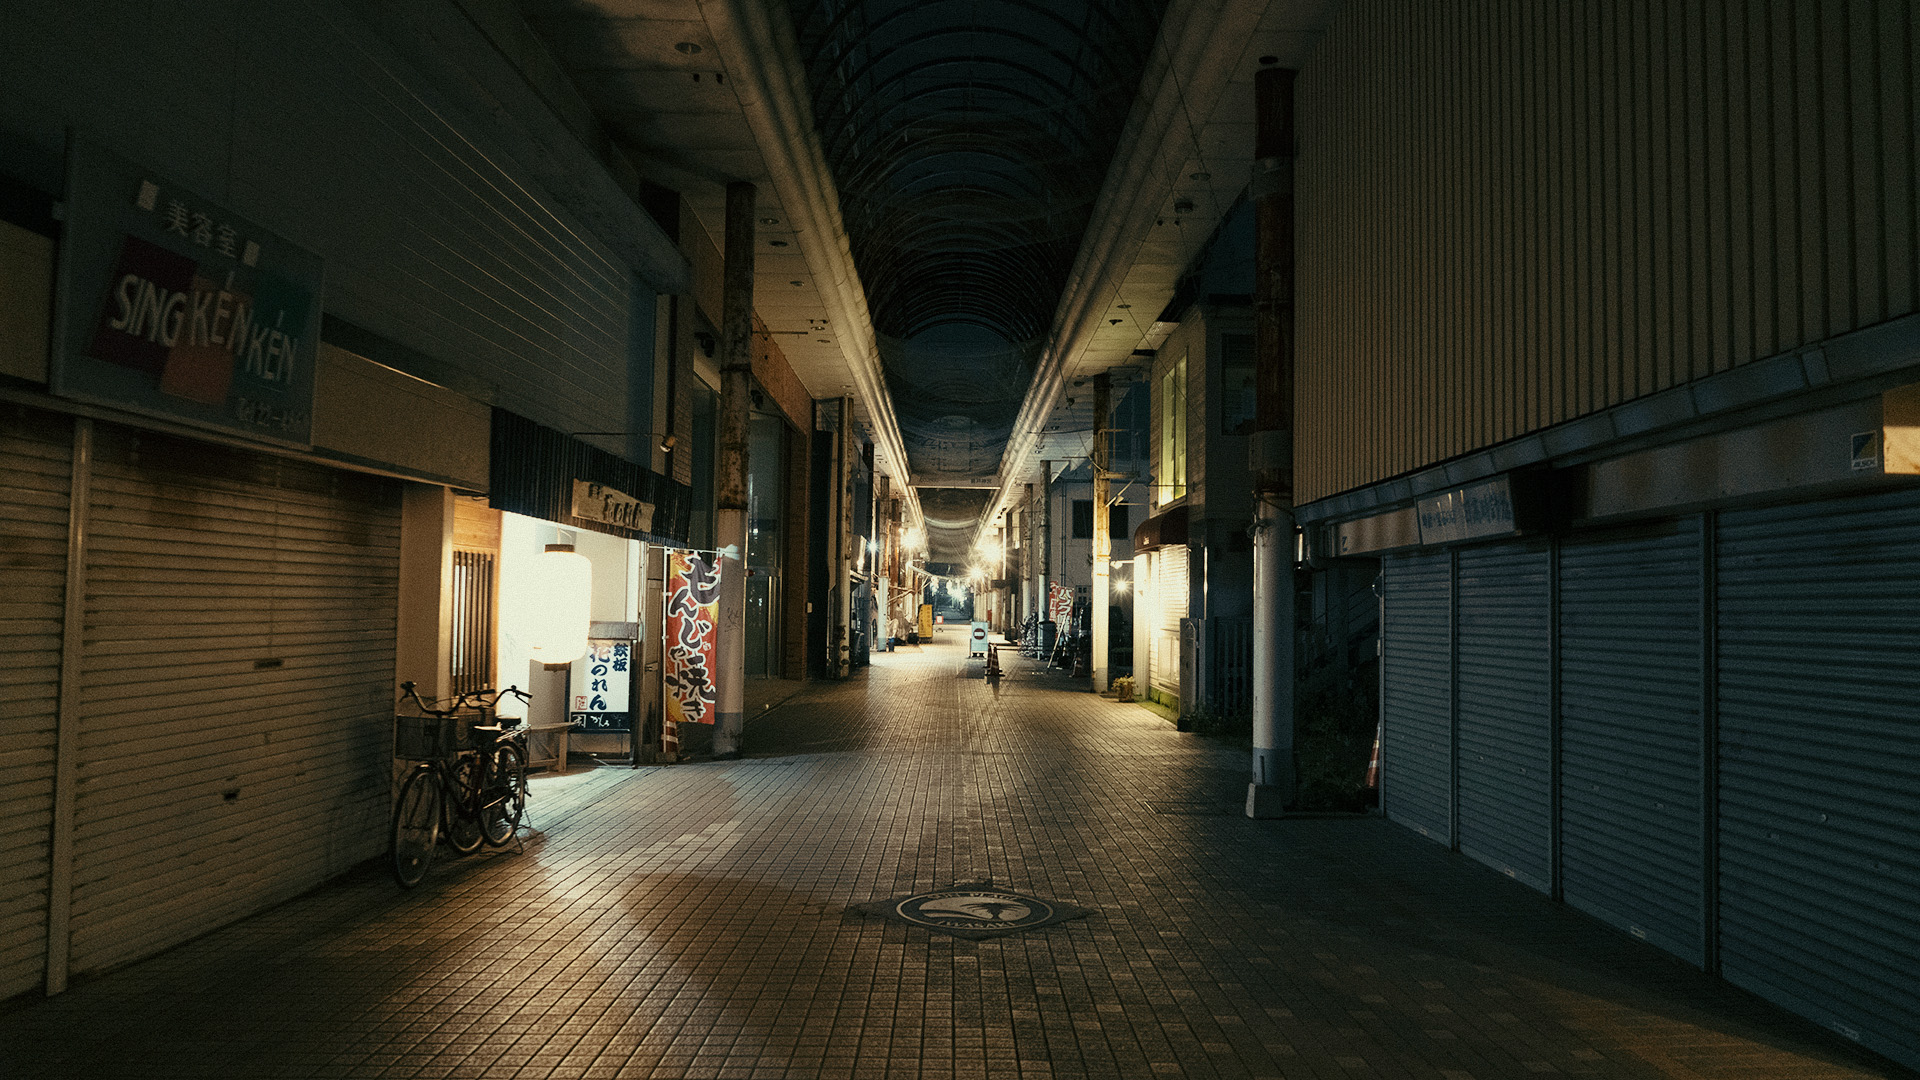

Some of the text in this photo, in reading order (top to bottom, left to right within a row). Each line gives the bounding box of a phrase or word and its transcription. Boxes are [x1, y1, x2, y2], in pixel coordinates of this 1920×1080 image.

[167, 199, 237, 258] 美容室
[110, 273, 187, 348] SING
[589, 642, 611, 711] 花のれん
[612, 642, 629, 672] 鉄板
